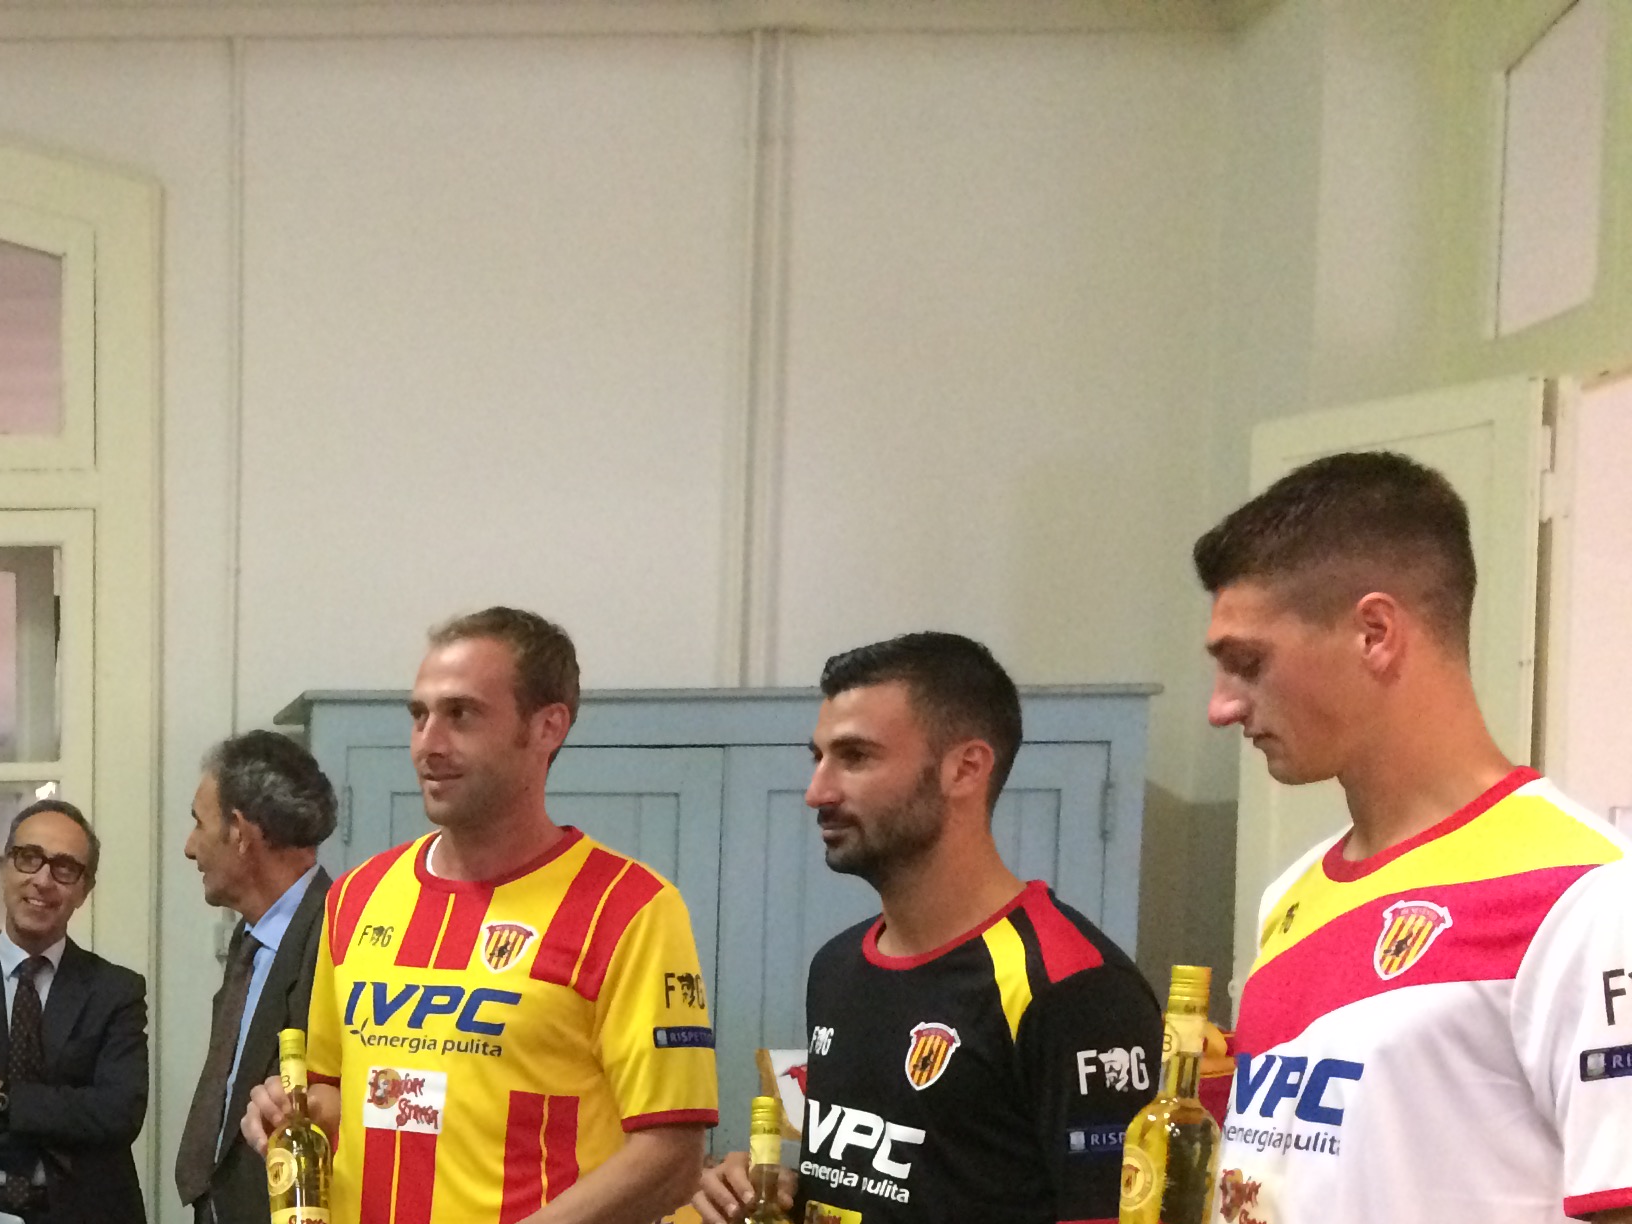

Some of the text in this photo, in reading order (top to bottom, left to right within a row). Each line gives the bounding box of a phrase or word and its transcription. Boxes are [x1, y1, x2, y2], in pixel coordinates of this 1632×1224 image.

[344, 981, 522, 1036] IVPC
[367, 1033, 502, 1057] energia pulita
[800, 1160, 859, 1188] energia
